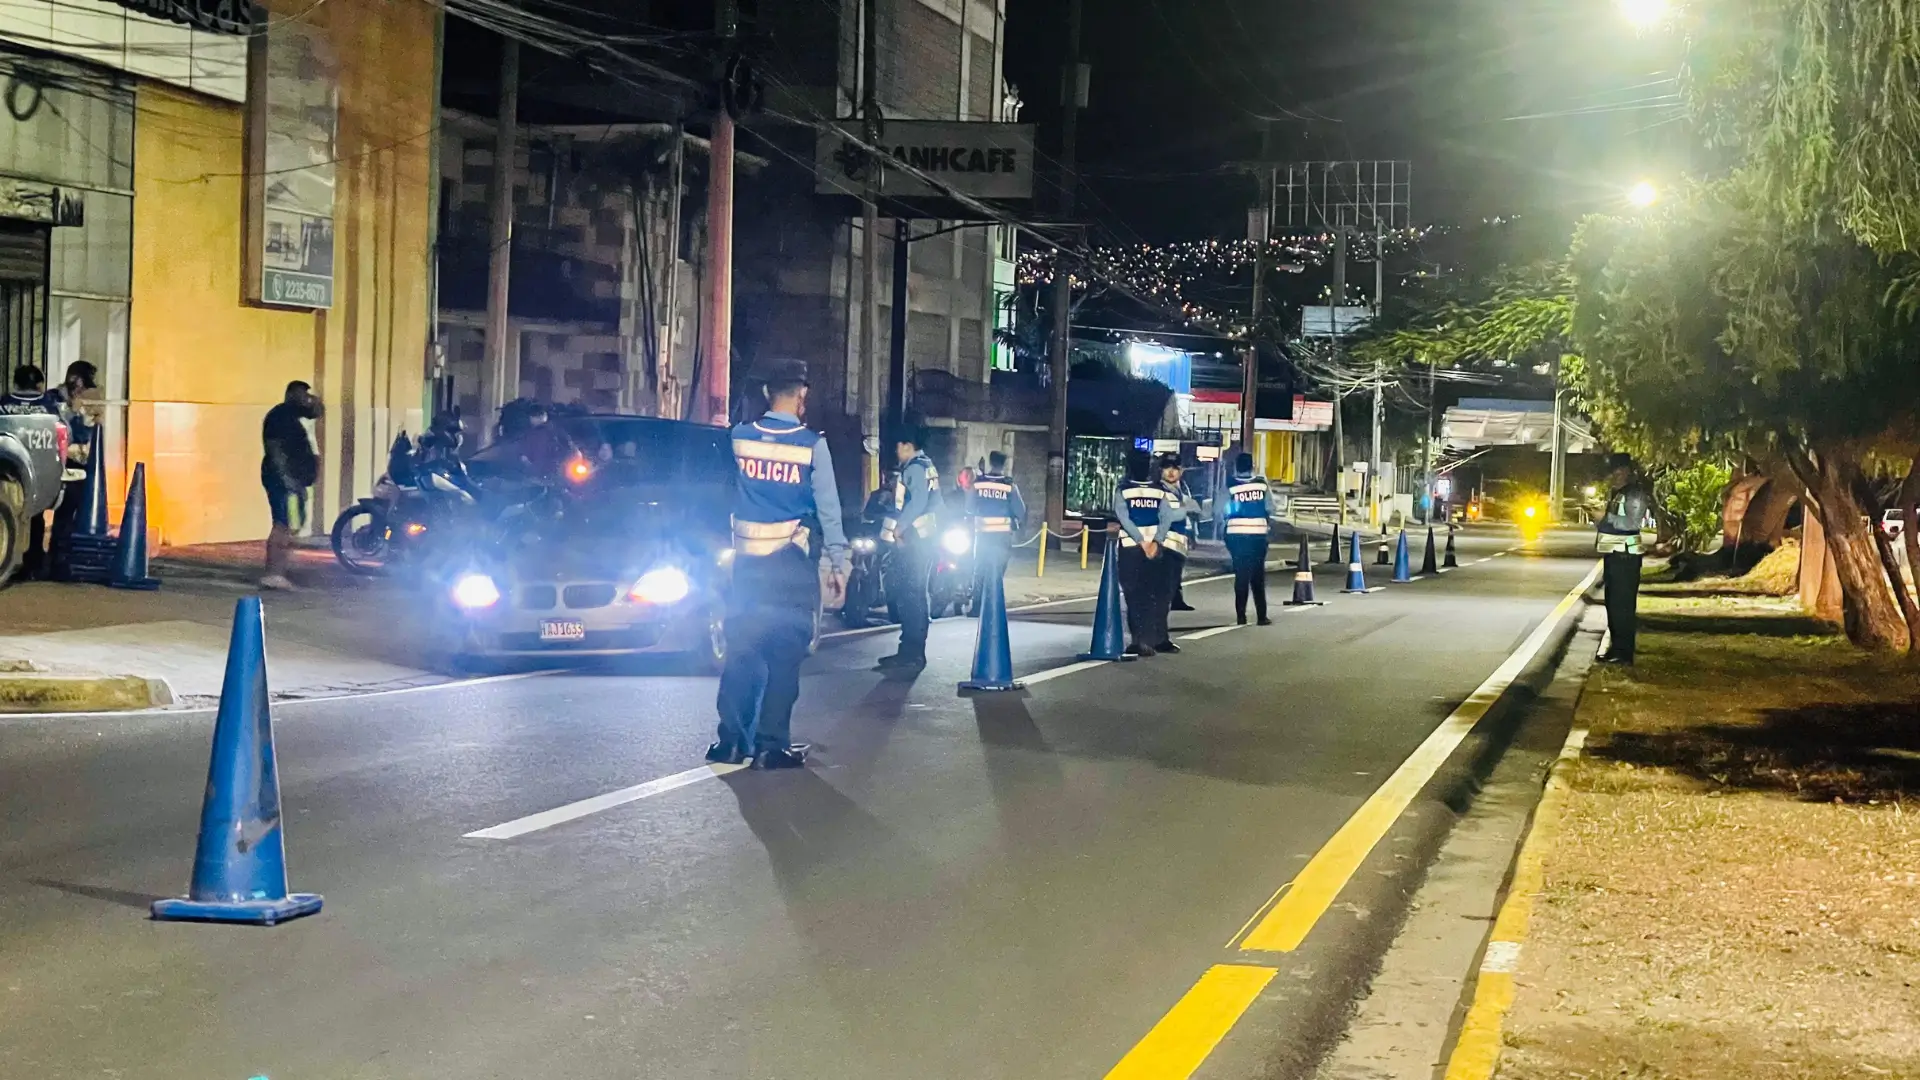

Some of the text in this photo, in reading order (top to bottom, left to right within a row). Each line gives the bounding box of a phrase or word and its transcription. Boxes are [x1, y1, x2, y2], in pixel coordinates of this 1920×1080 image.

[978, 489, 1007, 500] POLICIA
[1234, 490, 1263, 502] POLICIA
[1130, 499, 1158, 508] POLICIA
